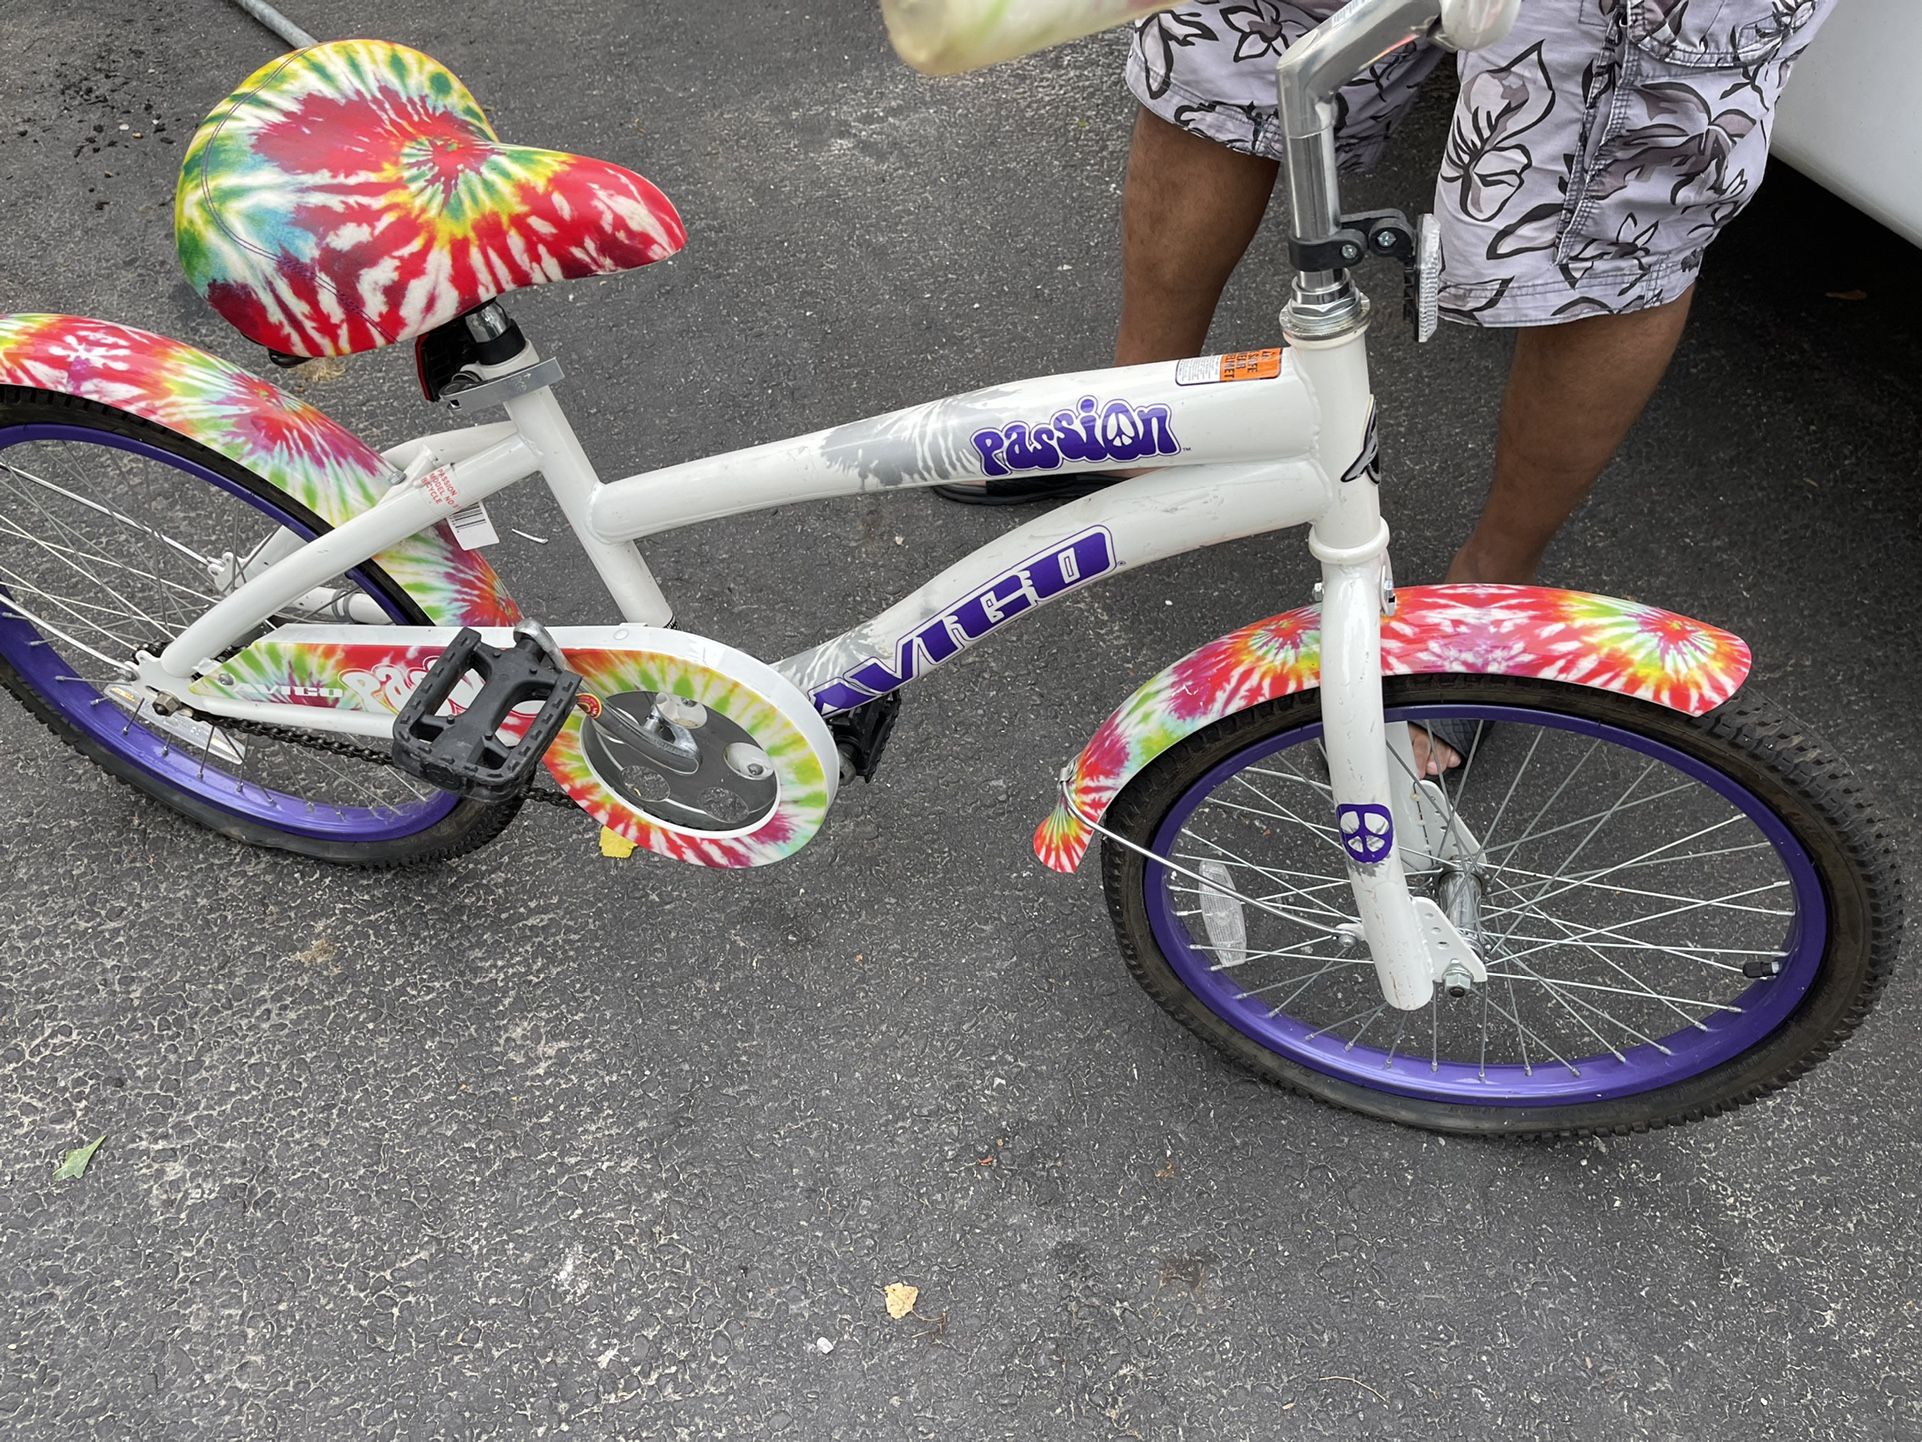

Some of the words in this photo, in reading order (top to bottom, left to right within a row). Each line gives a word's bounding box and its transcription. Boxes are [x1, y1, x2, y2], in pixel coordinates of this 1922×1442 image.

[1224, 353, 1236, 378] ELMET
[421, 477, 442, 504] BICYCLE
[430, 473, 445, 495] MODEL
[438, 469, 457, 496] PASSION
[807, 524, 1117, 718] AVIGO
[233, 682, 344, 698] AVIGO
